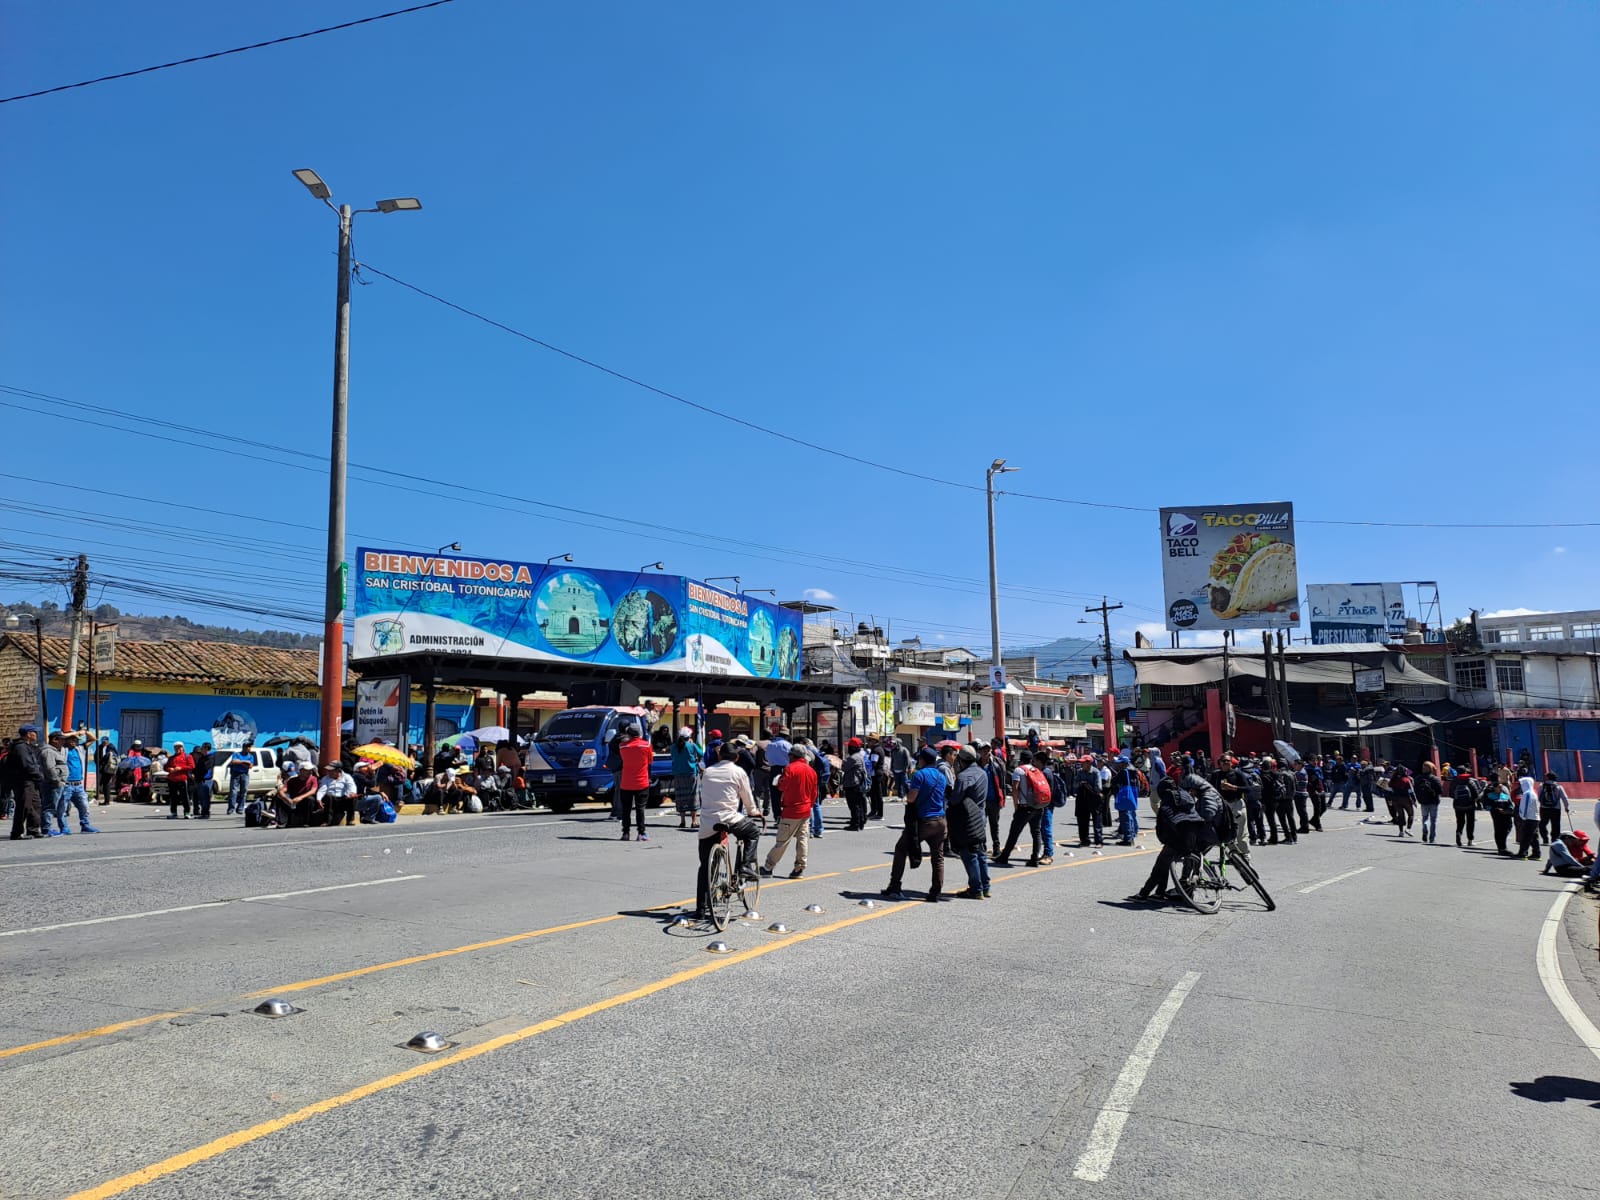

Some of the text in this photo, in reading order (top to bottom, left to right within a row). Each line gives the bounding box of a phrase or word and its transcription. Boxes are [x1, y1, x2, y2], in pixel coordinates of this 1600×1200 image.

[1166, 538, 1199, 547] TACO
[1169, 548, 1199, 557] BELL
[365, 552, 533, 585] BIENVENIDOS A
[365, 578, 532, 599] SAN CRISTÓBAL TOTONICAPÁN
[688, 582, 748, 616] BIENVENIDOS A
[410, 634, 485, 646] ADMINISTRACIÓN
[213, 688, 245, 696] TIENDA
[359, 707, 376, 715] Detén
[359, 716, 387, 726] búsqueda
